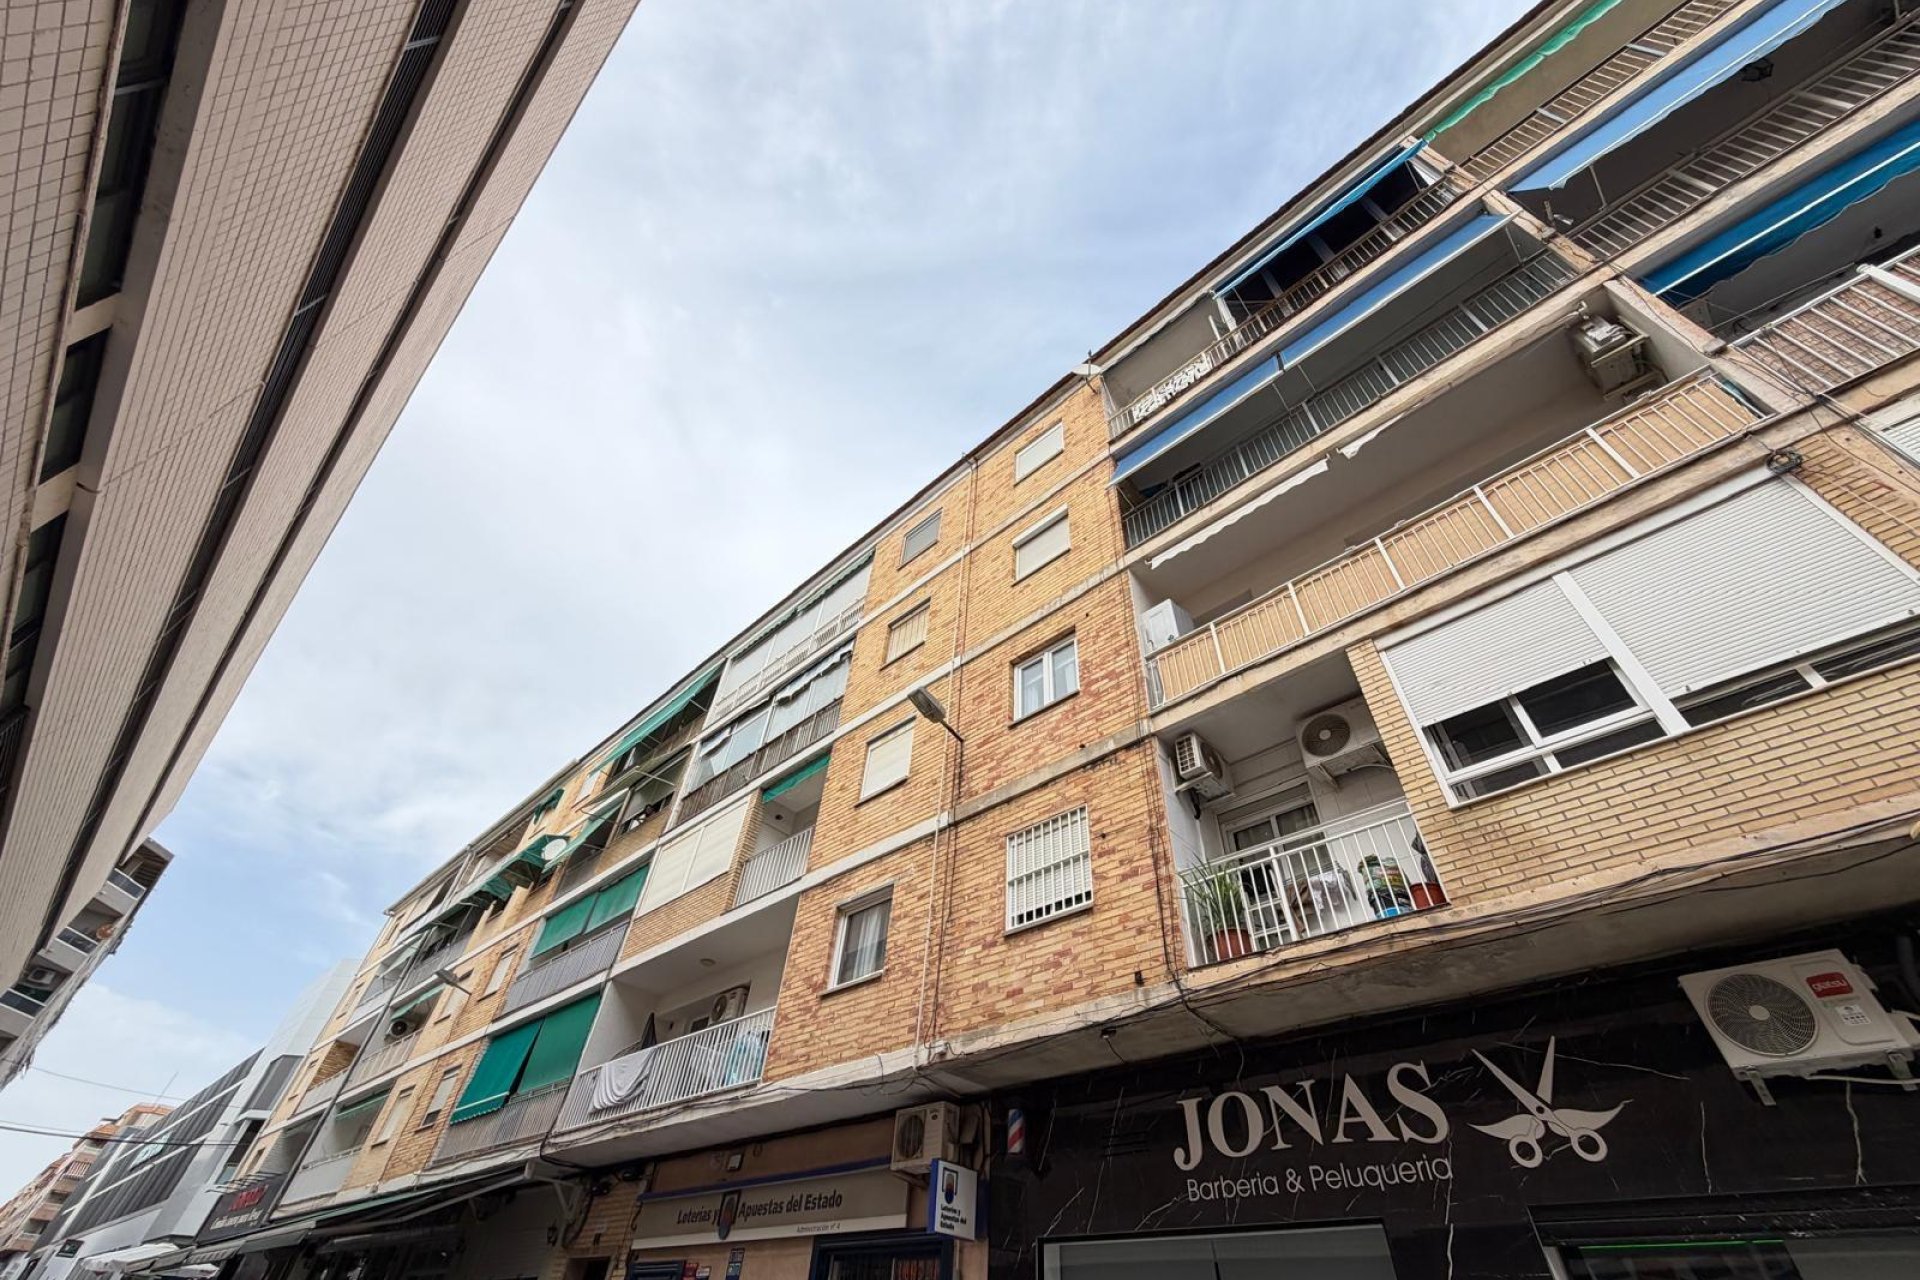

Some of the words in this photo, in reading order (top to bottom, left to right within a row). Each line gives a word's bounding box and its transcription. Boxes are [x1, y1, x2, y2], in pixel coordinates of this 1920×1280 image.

[1173, 1060, 1451, 1171] JONAS
[1186, 1172, 1279, 1202] Barberia
[1285, 1168, 1305, 1194] &
[1308, 1154, 1453, 1192] Peluqueria
[711, 1208, 720, 1226] y
[737, 1198, 784, 1222] Apuestas
[786, 1193, 803, 1213] del
[804, 1189, 843, 1211] Estado
